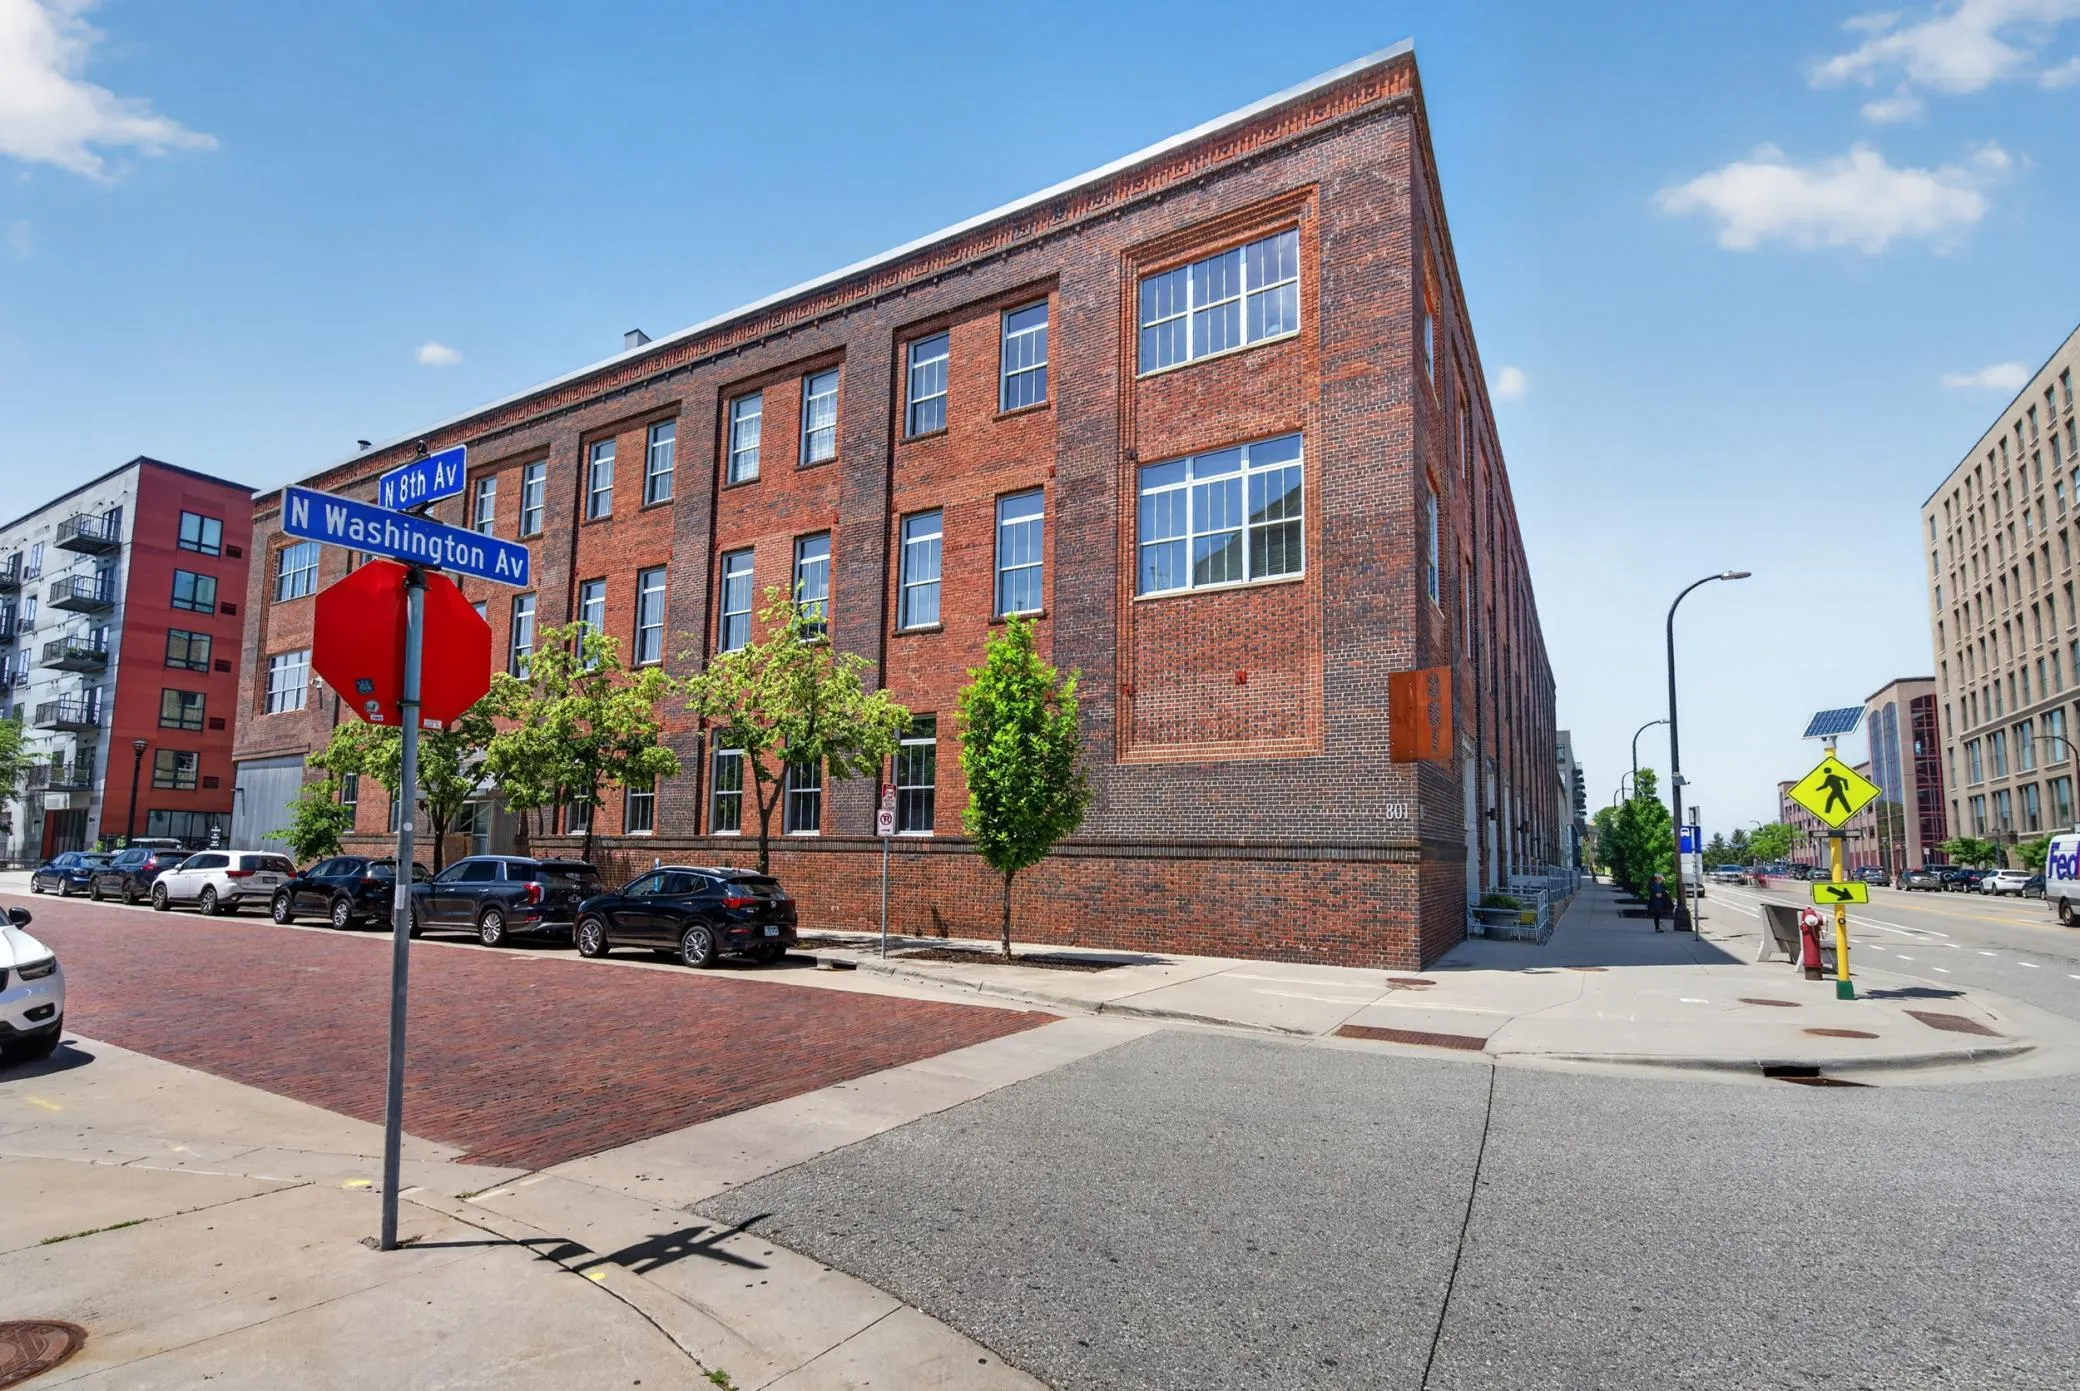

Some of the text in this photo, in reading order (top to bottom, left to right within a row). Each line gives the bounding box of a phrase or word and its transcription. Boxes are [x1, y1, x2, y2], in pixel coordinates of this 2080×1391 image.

[385, 462, 457, 506] N 8th Av
[292, 496, 524, 578] N Washington Av
[1386, 803, 1408, 820] 801
[2048, 841, 2080, 880] Fed
